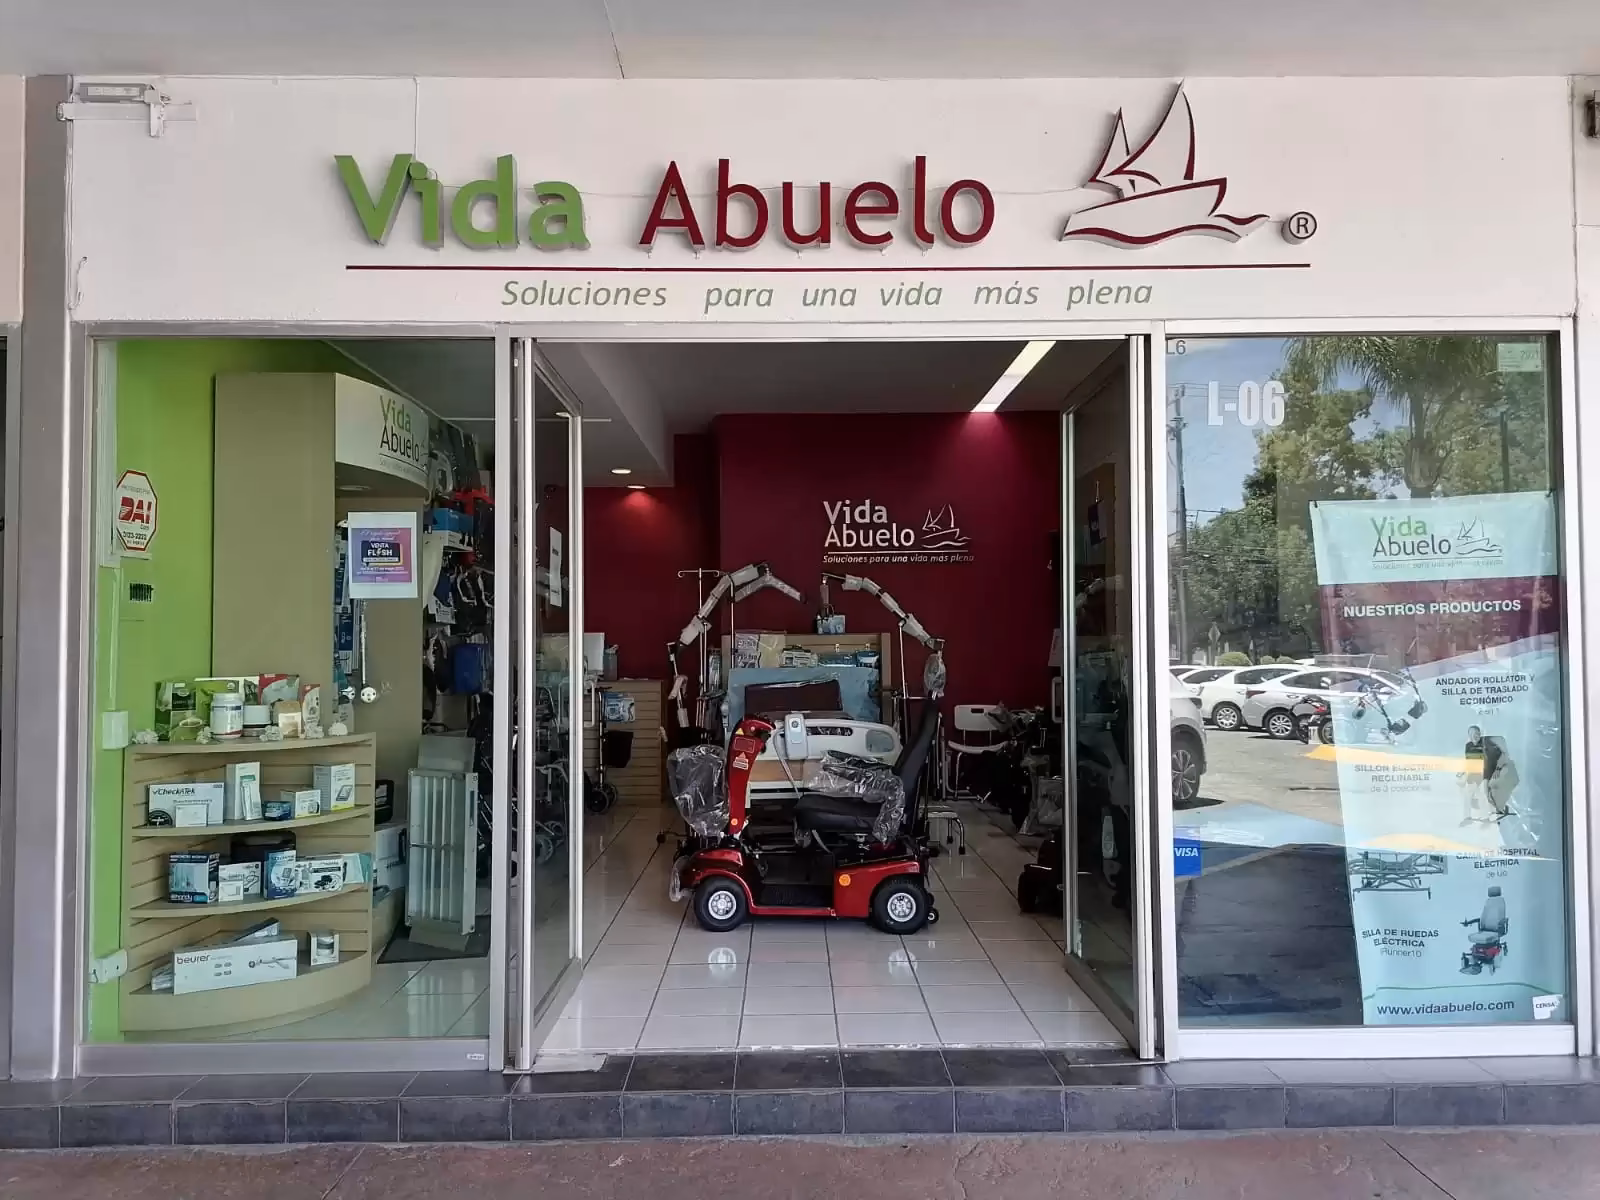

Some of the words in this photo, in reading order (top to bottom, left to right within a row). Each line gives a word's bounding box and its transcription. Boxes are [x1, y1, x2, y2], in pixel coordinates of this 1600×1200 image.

[334, 153, 590, 250] Vida
[638, 156, 996, 249] Abuelo
[501, 279, 668, 307] Soluciones
[703, 286, 775, 315] para
[802, 286, 857, 307] una
[880, 281, 943, 307] vida
[974, 280, 1040, 306] más
[1066, 279, 1153, 311] plena
[1165, 340, 1187, 355] L6
[1207, 380, 1286, 427] L-06
[380, 395, 411, 433] Vida
[380, 423, 420, 462] Abuelo
[823, 499, 889, 525] Vida
[824, 523, 916, 548] Abuelo
[1370, 515, 1428, 537] Vida
[1372, 534, 1452, 557] Abuelo
[822, 554, 868, 564] Soluciones
[869, 555, 889, 565] para
[891, 555, 908, 563] una
[910, 553, 928, 563] vida
[1343, 602, 1425, 618] NUESTROS
[1429, 599, 1522, 616] PRODUCTOS
[1435, 676, 1481, 686] ANDADOR
[1483, 674, 1526, 684] ROLLATOR
[1441, 688, 1467, 696] SILLA
[1469, 687, 1483, 695] DE
[1485, 685, 1529, 694] TRASLADO
[1174, 847, 1199, 857] VISA
[1361, 928, 1381, 939] SILLA
[1383, 928, 1398, 937] DE
[1400, 929, 1440, 939] RUEDAS
[1373, 937, 1426, 948] ELÉCTRICA
[176, 954, 211, 965] beurer
[1376, 999, 1515, 1015] www.vidaabuelo.com
